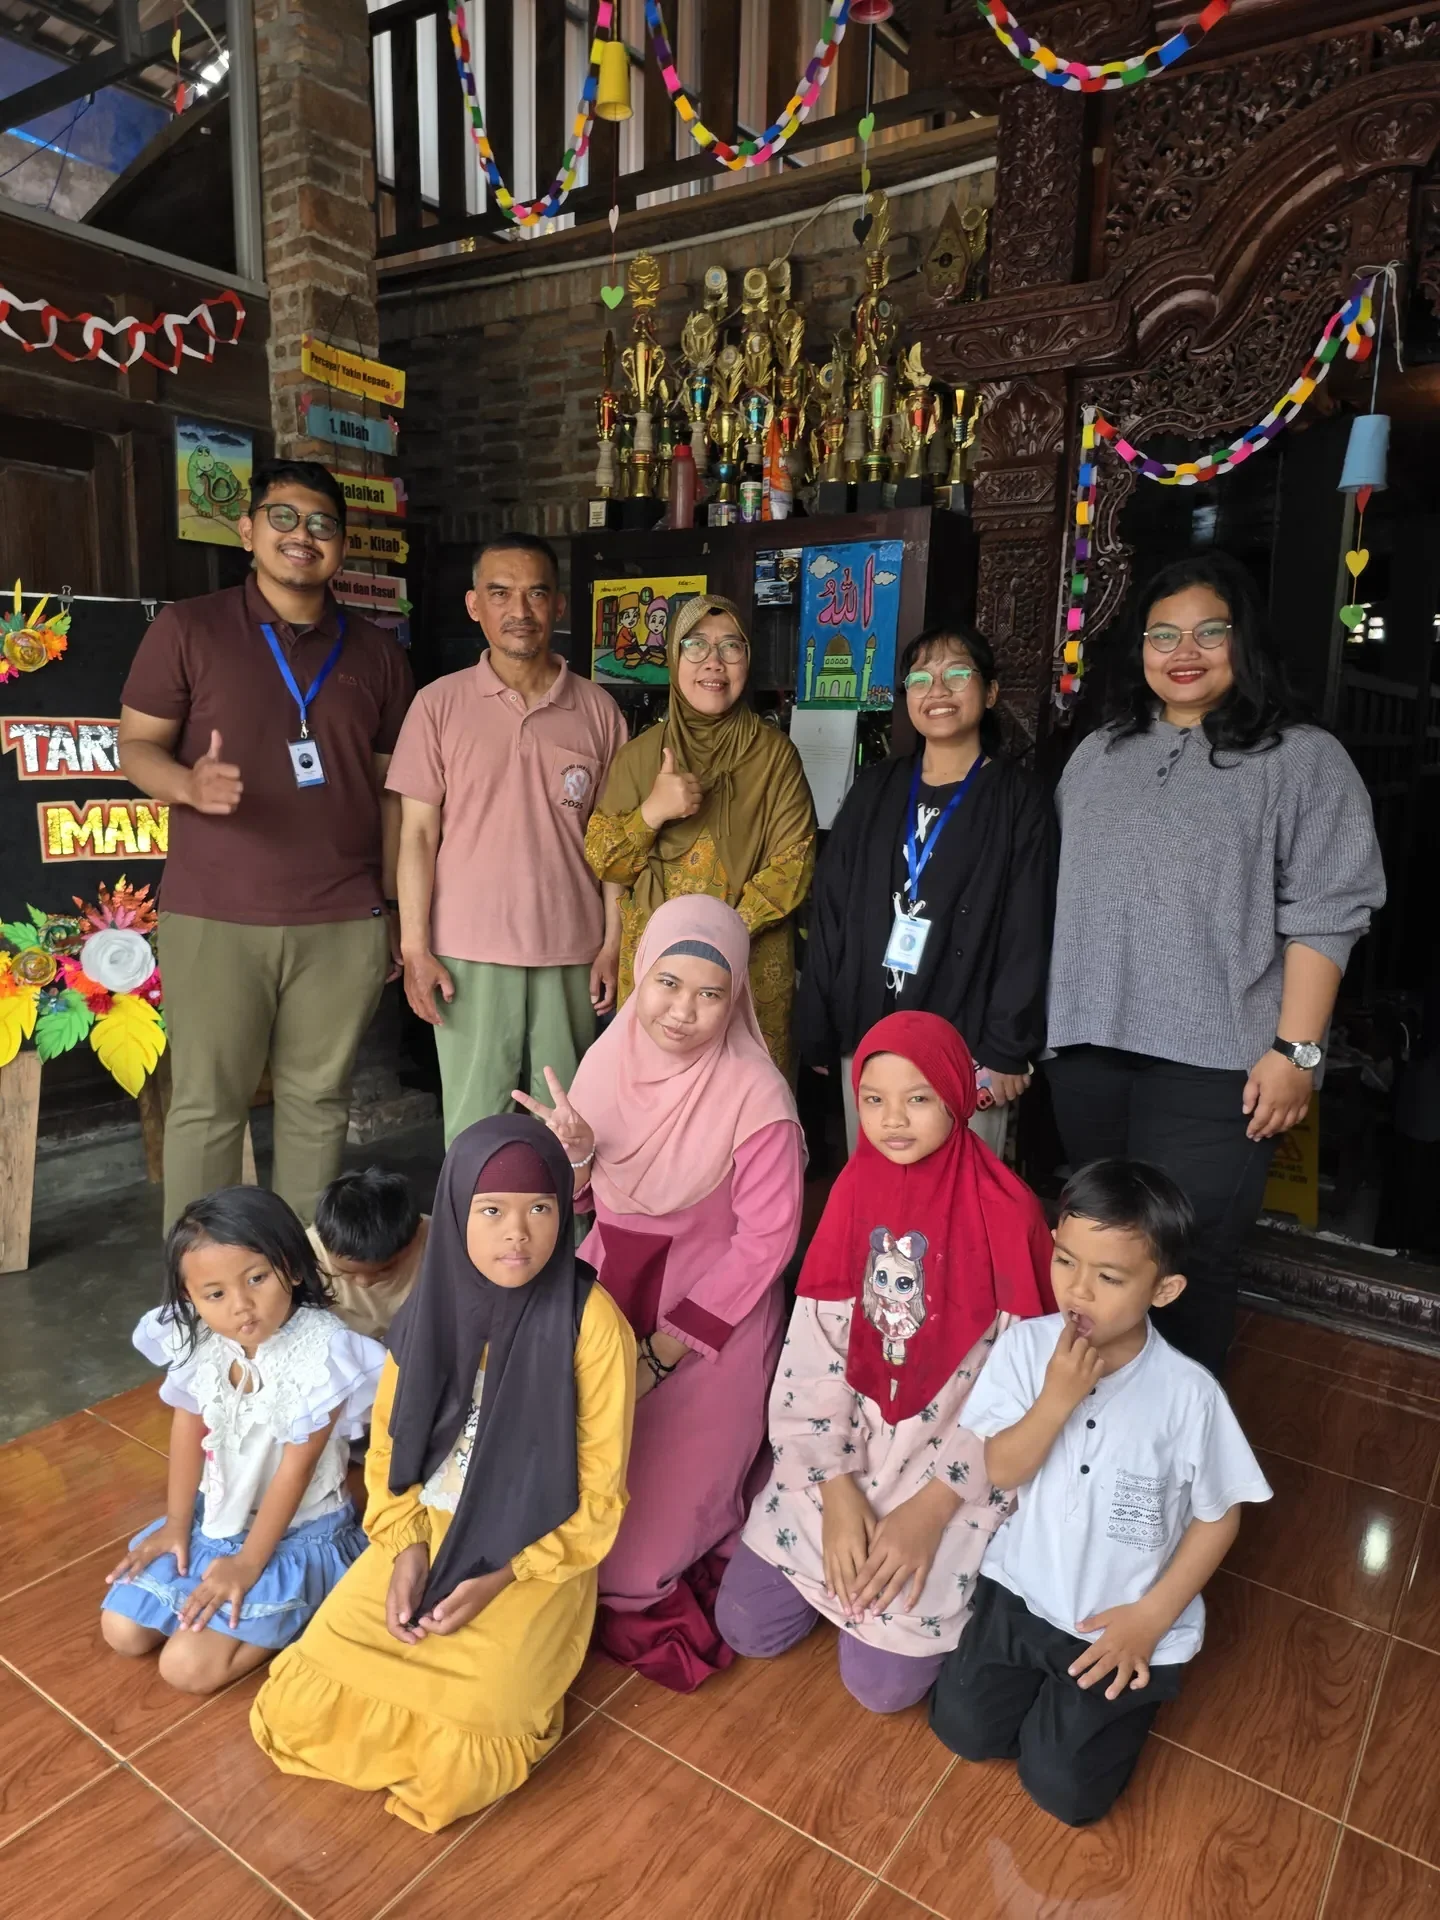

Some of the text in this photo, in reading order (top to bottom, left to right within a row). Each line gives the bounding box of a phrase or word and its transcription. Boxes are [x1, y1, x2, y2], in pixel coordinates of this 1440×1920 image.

[311, 351, 341, 373] Percaya/
[342, 365, 361, 381] Yakin
[362, 372, 391, 389] Kepada
[329, 418, 370, 442] 1. Allah
[370, 535, 400, 553] Kitab
[332, 579, 396, 599] Nabi dan Rasul
[561, 798, 584, 810] 2025
